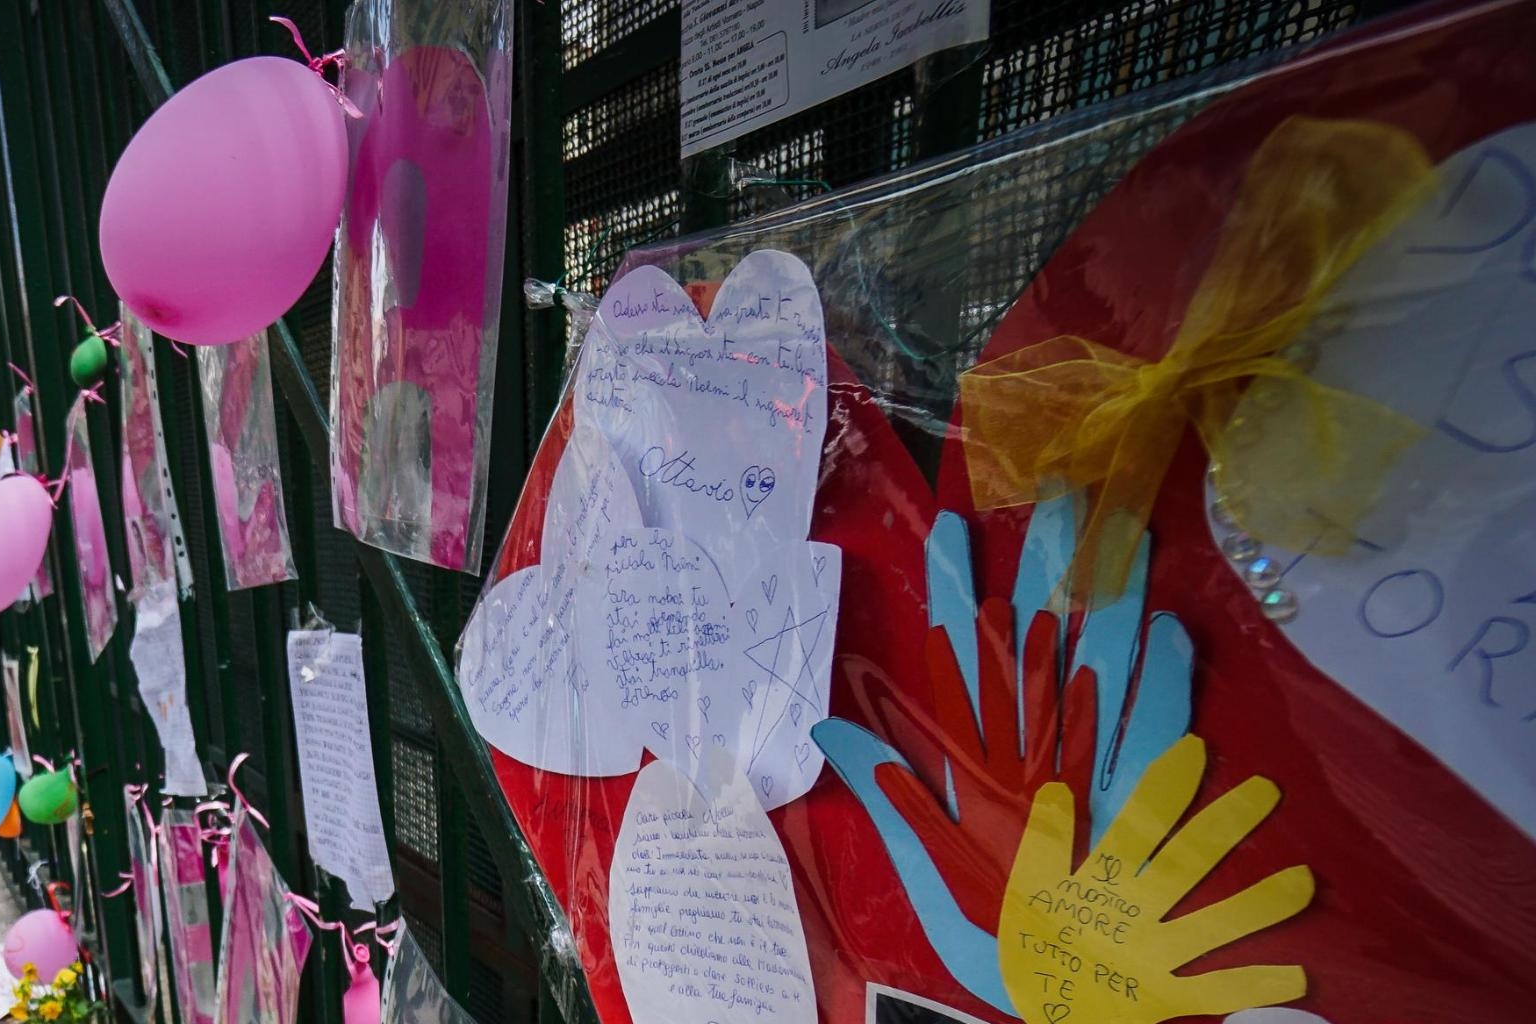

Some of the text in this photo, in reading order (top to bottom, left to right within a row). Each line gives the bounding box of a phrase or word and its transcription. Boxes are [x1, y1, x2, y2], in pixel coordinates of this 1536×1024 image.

[820, 36, 881, 76] Angela
[638, 444, 735, 504] Ottavio
[1028, 889, 1131, 945] AMORE
[1056, 878, 1141, 919] nostro
[1018, 932, 1140, 1002] TUTTO PER
[1033, 970, 1077, 1001] TE
